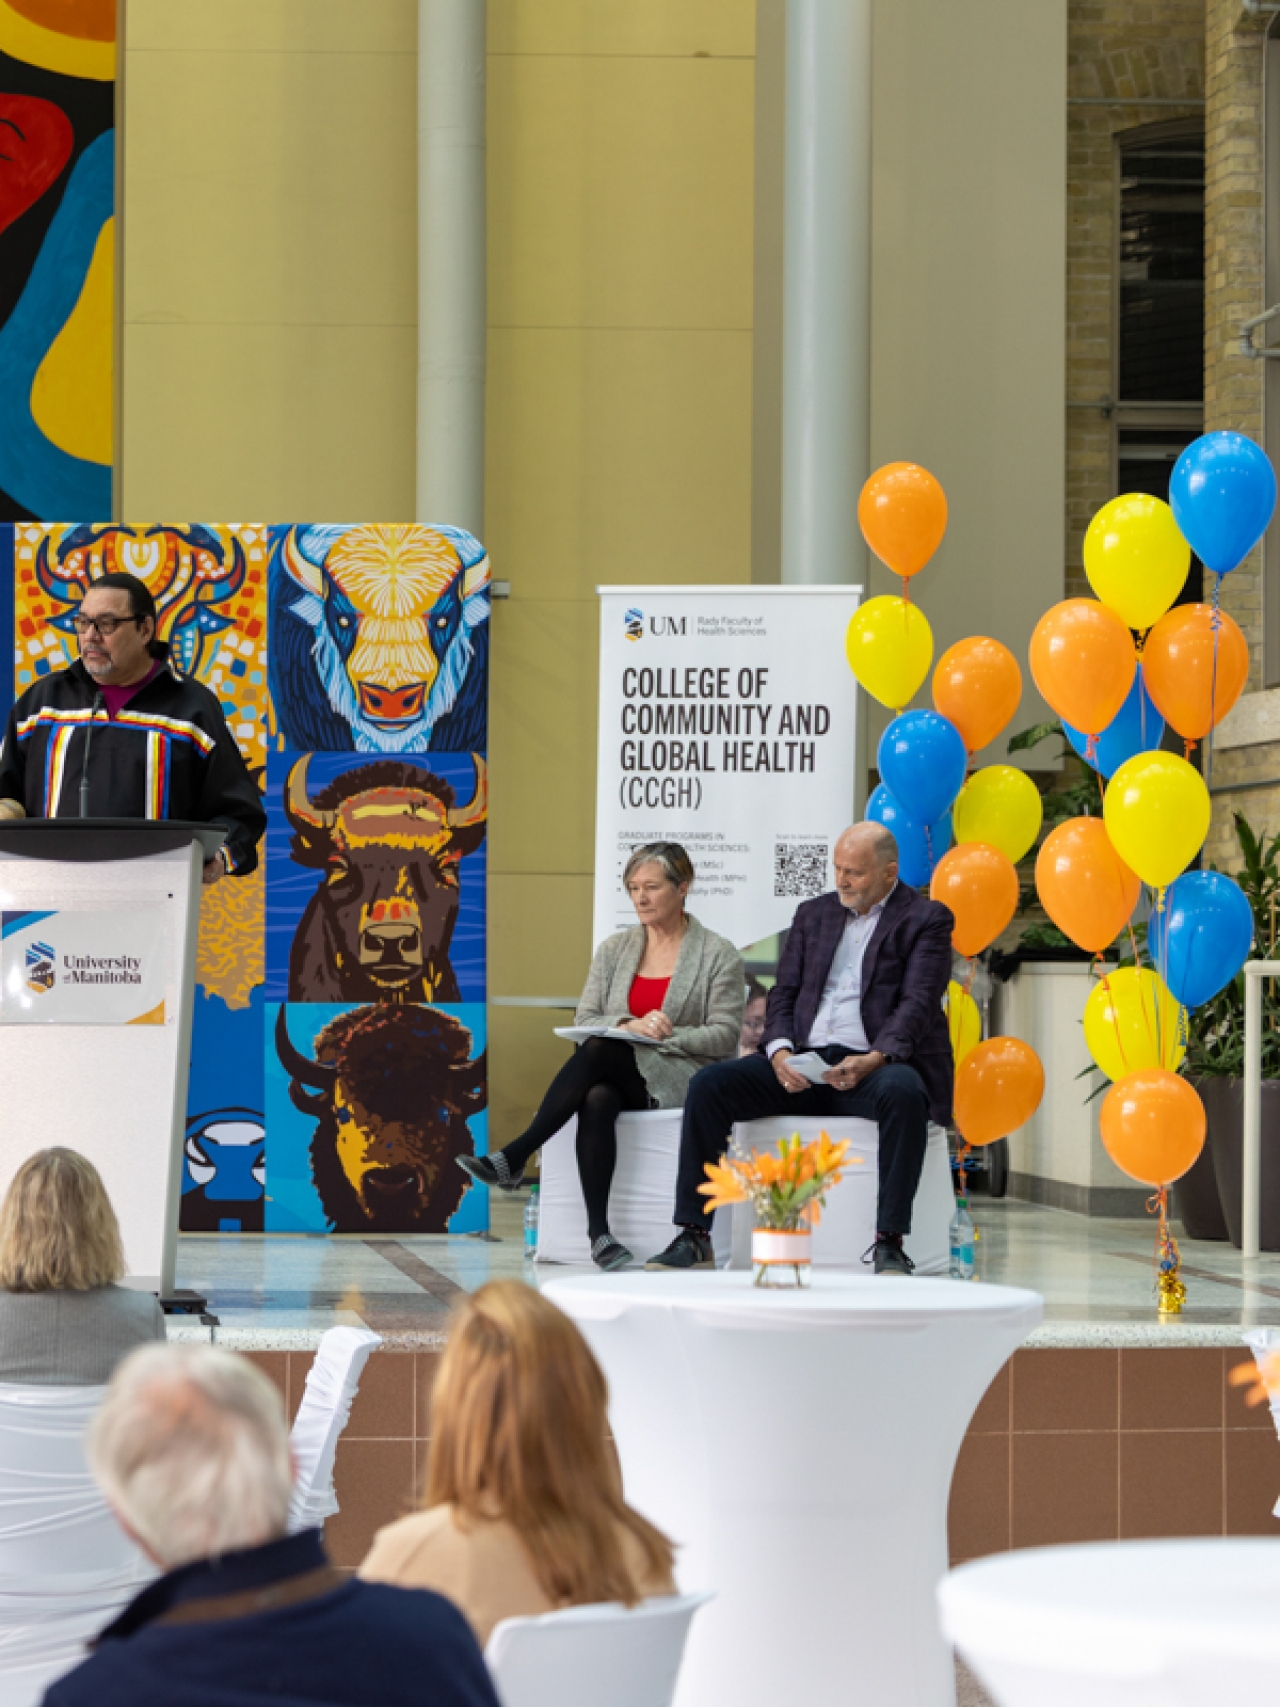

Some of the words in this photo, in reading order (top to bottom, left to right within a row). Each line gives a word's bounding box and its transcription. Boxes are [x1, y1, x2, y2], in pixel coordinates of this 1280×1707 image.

[650, 617, 686, 636] UM
[622, 667, 731, 699] COLLEGE
[737, 667, 769, 699] OF
[621, 703, 773, 735] COMMUNITY
[778, 705, 831, 735] AND
[620, 739, 716, 772] GLOBAL
[722, 741, 816, 773] HEALTH
[619, 775, 703, 810] (CCGH)
[617, 831, 663, 841] GRADUATE
[665, 831, 713, 841] PROGRAMS
[63, 955, 142, 972] University
[72, 970, 142, 985] Manitoba
